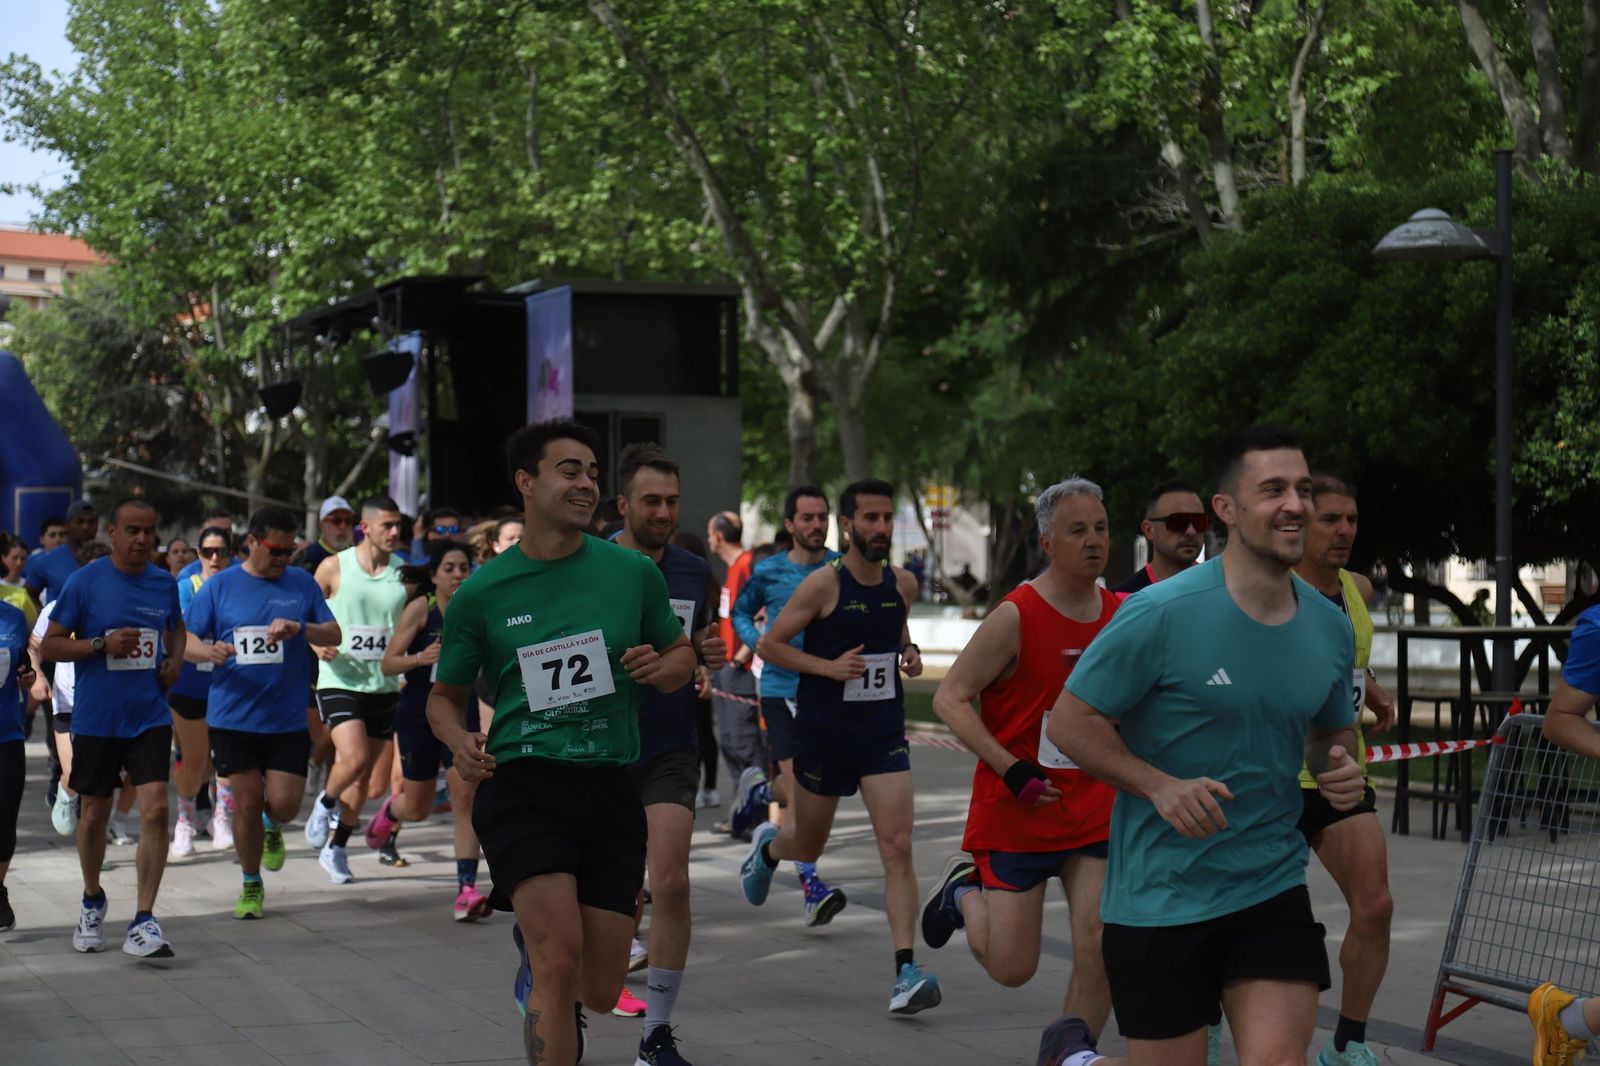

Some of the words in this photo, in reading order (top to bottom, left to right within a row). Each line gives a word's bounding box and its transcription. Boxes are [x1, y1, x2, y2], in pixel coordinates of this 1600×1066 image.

[506, 614, 532, 627] JAKO
[351, 635, 386, 651] 244
[522, 650, 535, 659] DÍA
[535, 648, 545, 656] DE
[545, 641, 575, 653] CASTILLA
[581, 635, 600, 645] LEÓN
[541, 654, 593, 691] 72
[862, 667, 886, 690] 15
